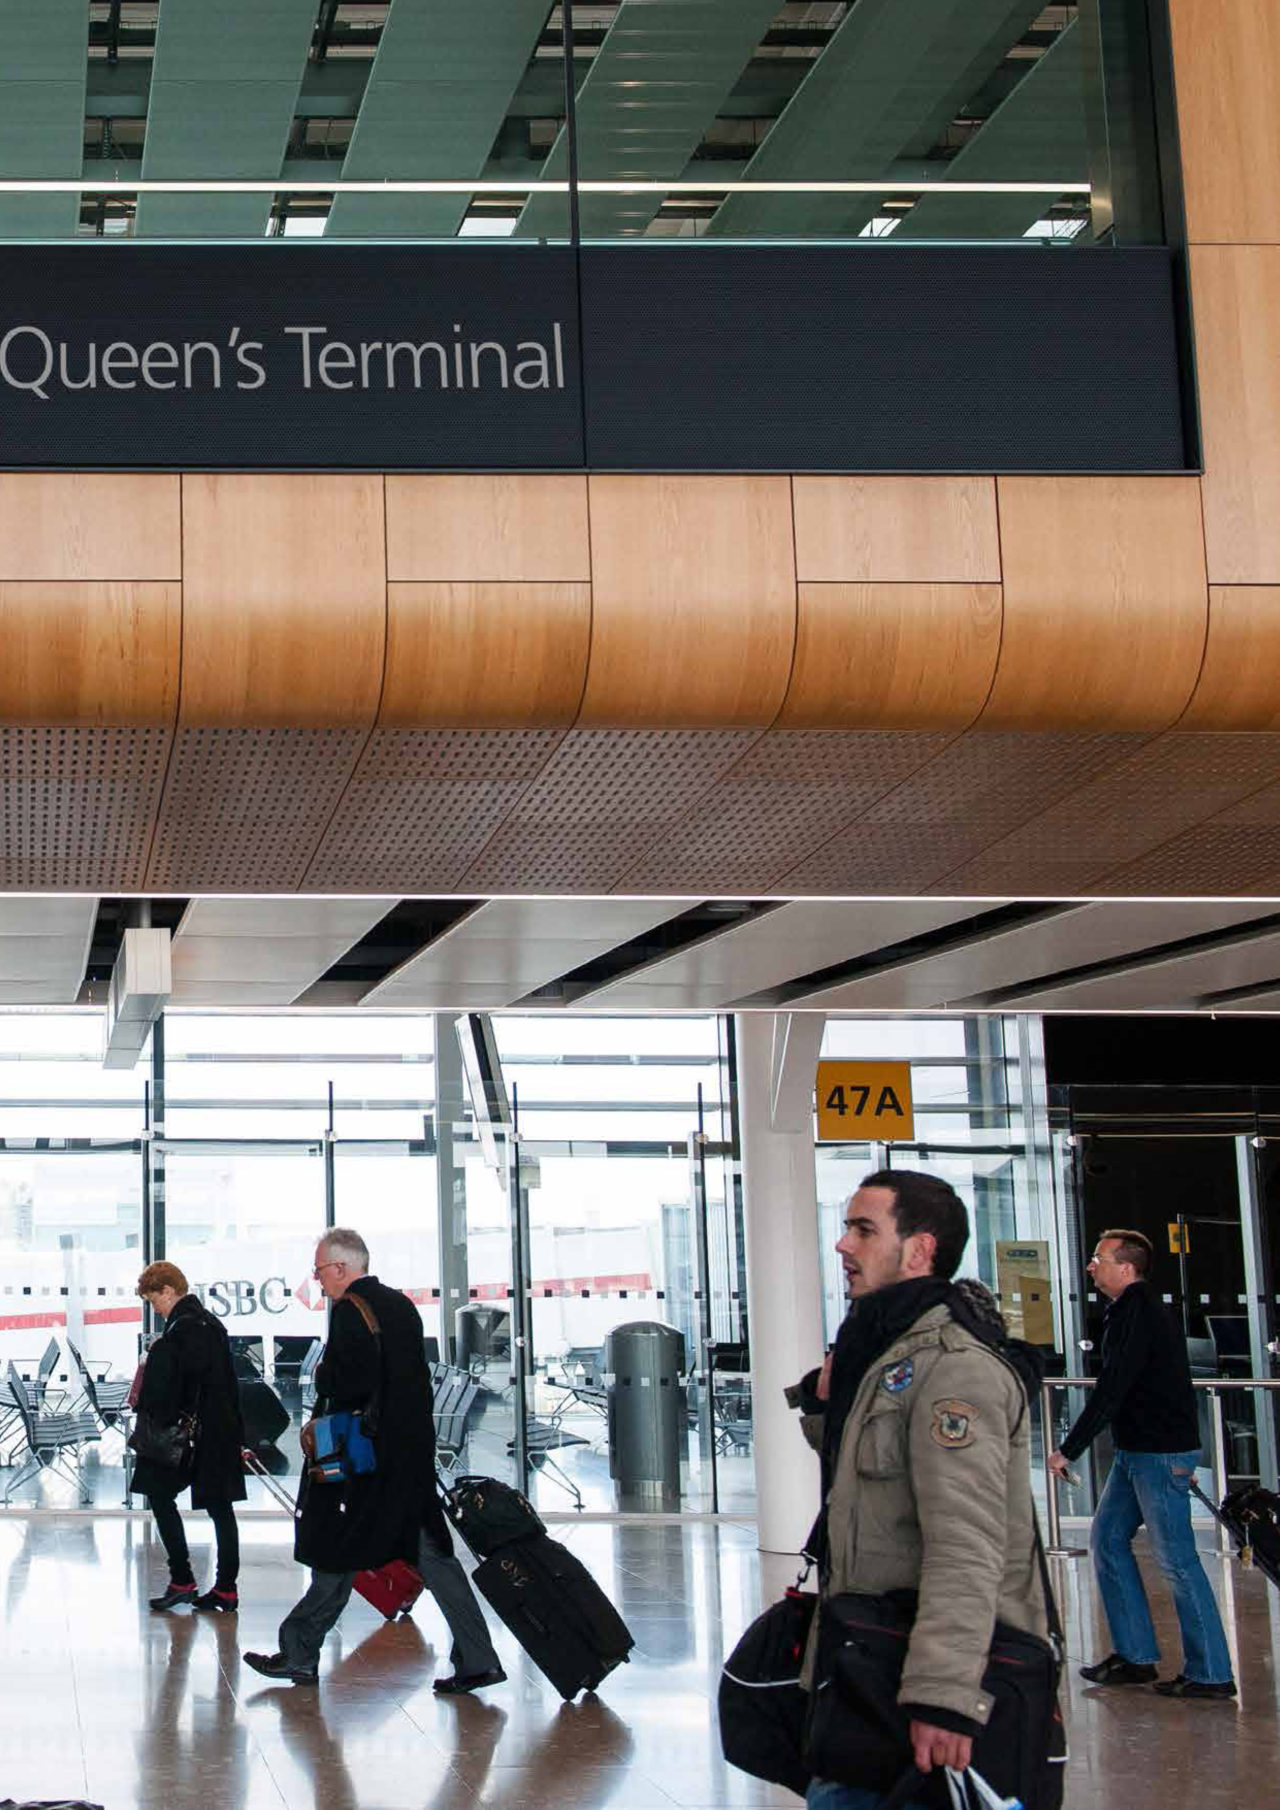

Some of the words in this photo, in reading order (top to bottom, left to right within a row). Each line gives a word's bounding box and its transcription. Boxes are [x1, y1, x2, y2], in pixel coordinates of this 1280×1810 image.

[0, 326, 266, 400] Queen's
[284, 322, 565, 390] Terminal
[826, 1085, 905, 1117] 47A
